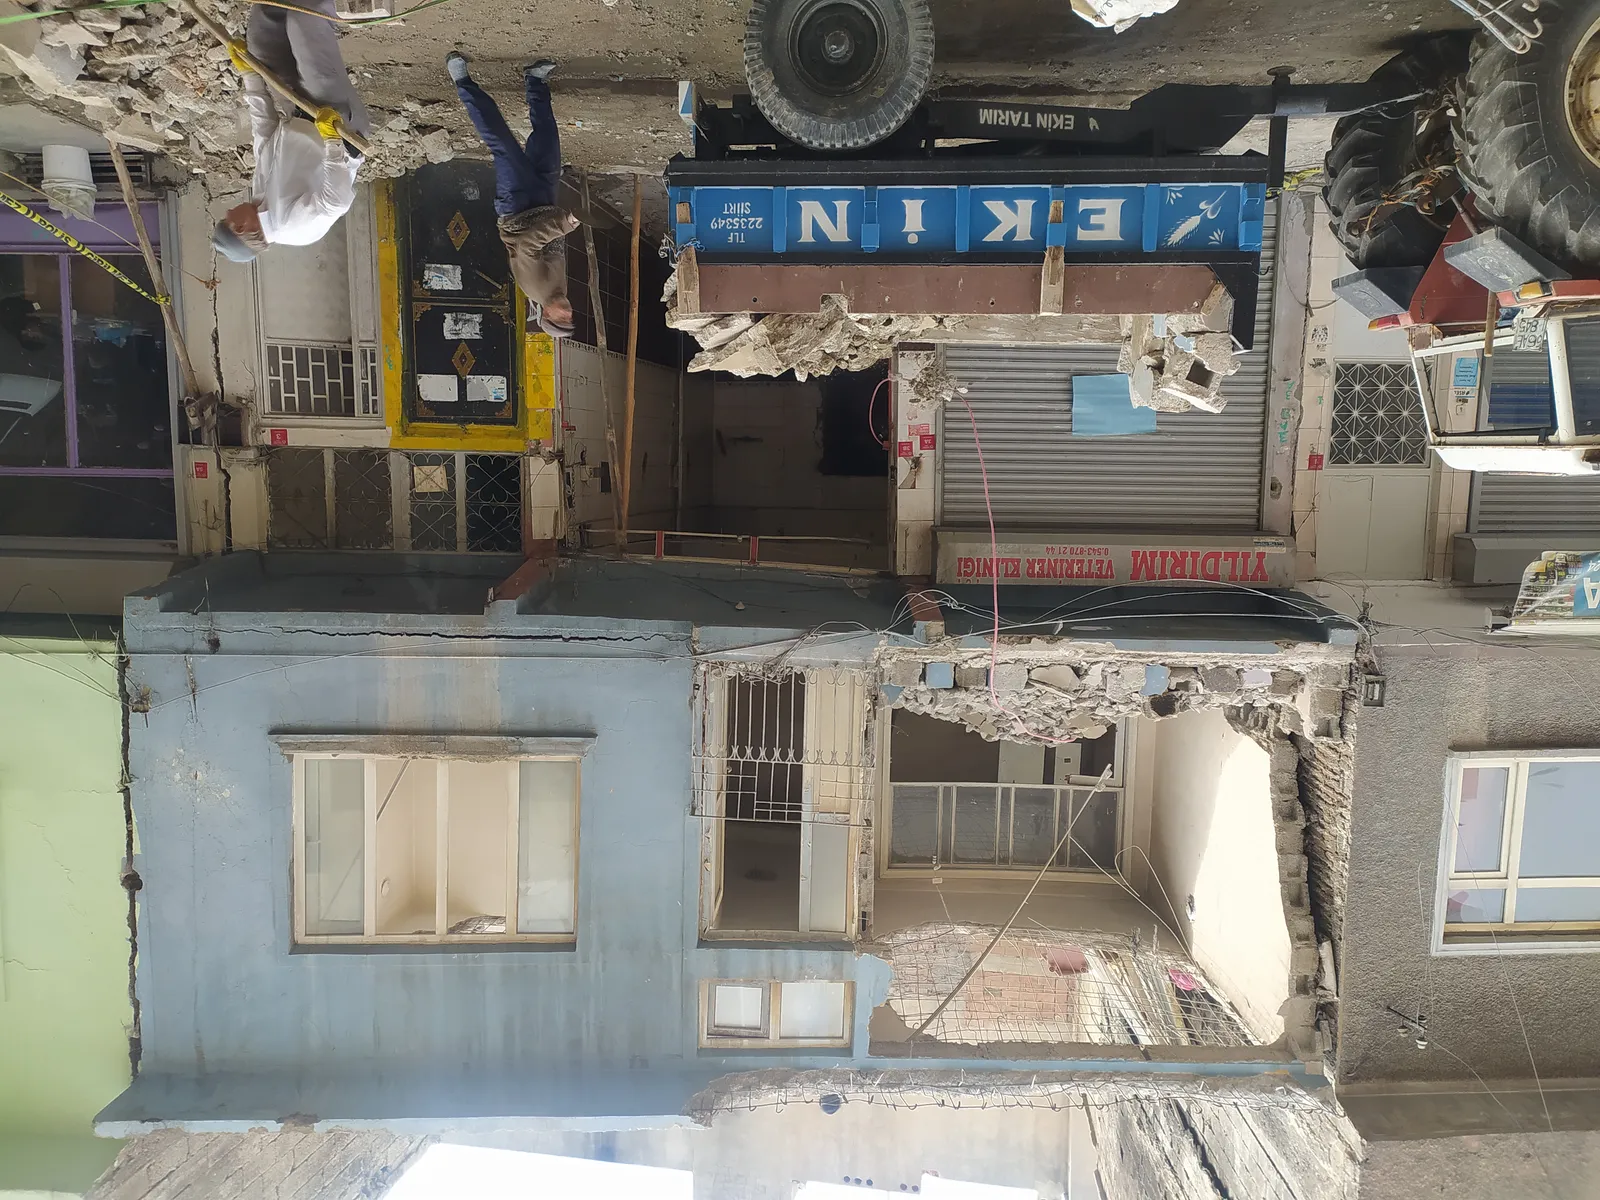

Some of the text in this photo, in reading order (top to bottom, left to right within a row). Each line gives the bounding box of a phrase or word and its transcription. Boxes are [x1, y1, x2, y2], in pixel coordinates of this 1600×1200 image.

[979, 108, 1074, 132] EKİN TARIM
[710, 217, 763, 229] 2235349
[727, 232, 745, 243] TLF
[1026, 558, 1115, 584] VETERİNER
[1129, 550, 1269, 582] YILDIRIM
[1583, 577, 1600, 608] A
